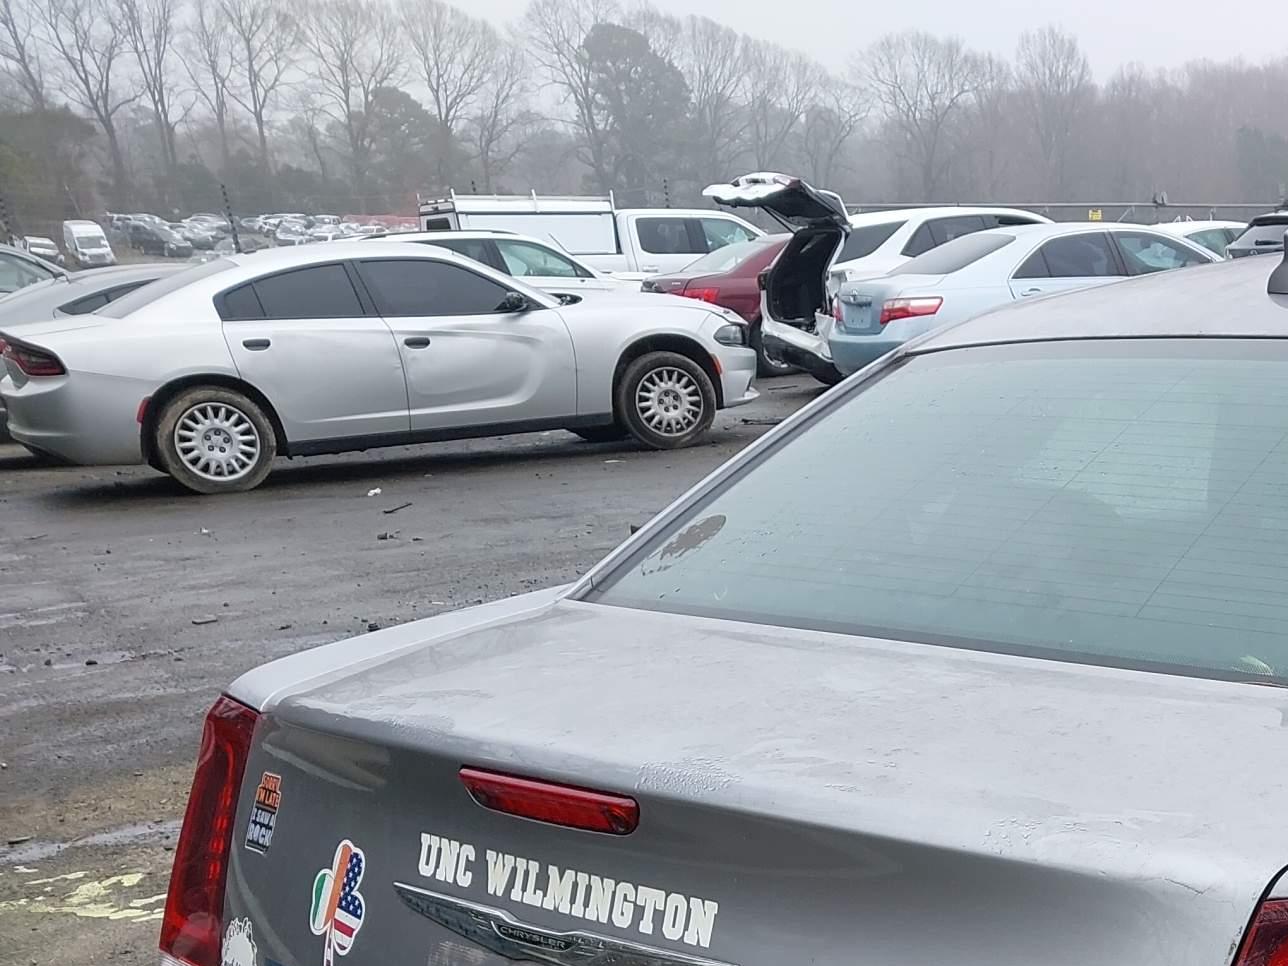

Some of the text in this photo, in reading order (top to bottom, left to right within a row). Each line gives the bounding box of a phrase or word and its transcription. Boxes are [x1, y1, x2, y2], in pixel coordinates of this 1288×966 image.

[247, 822, 273, 846] ROCK
[417, 832, 719, 948] UNC WILMINGTON
[500, 926, 566, 949] CHRYSLER
